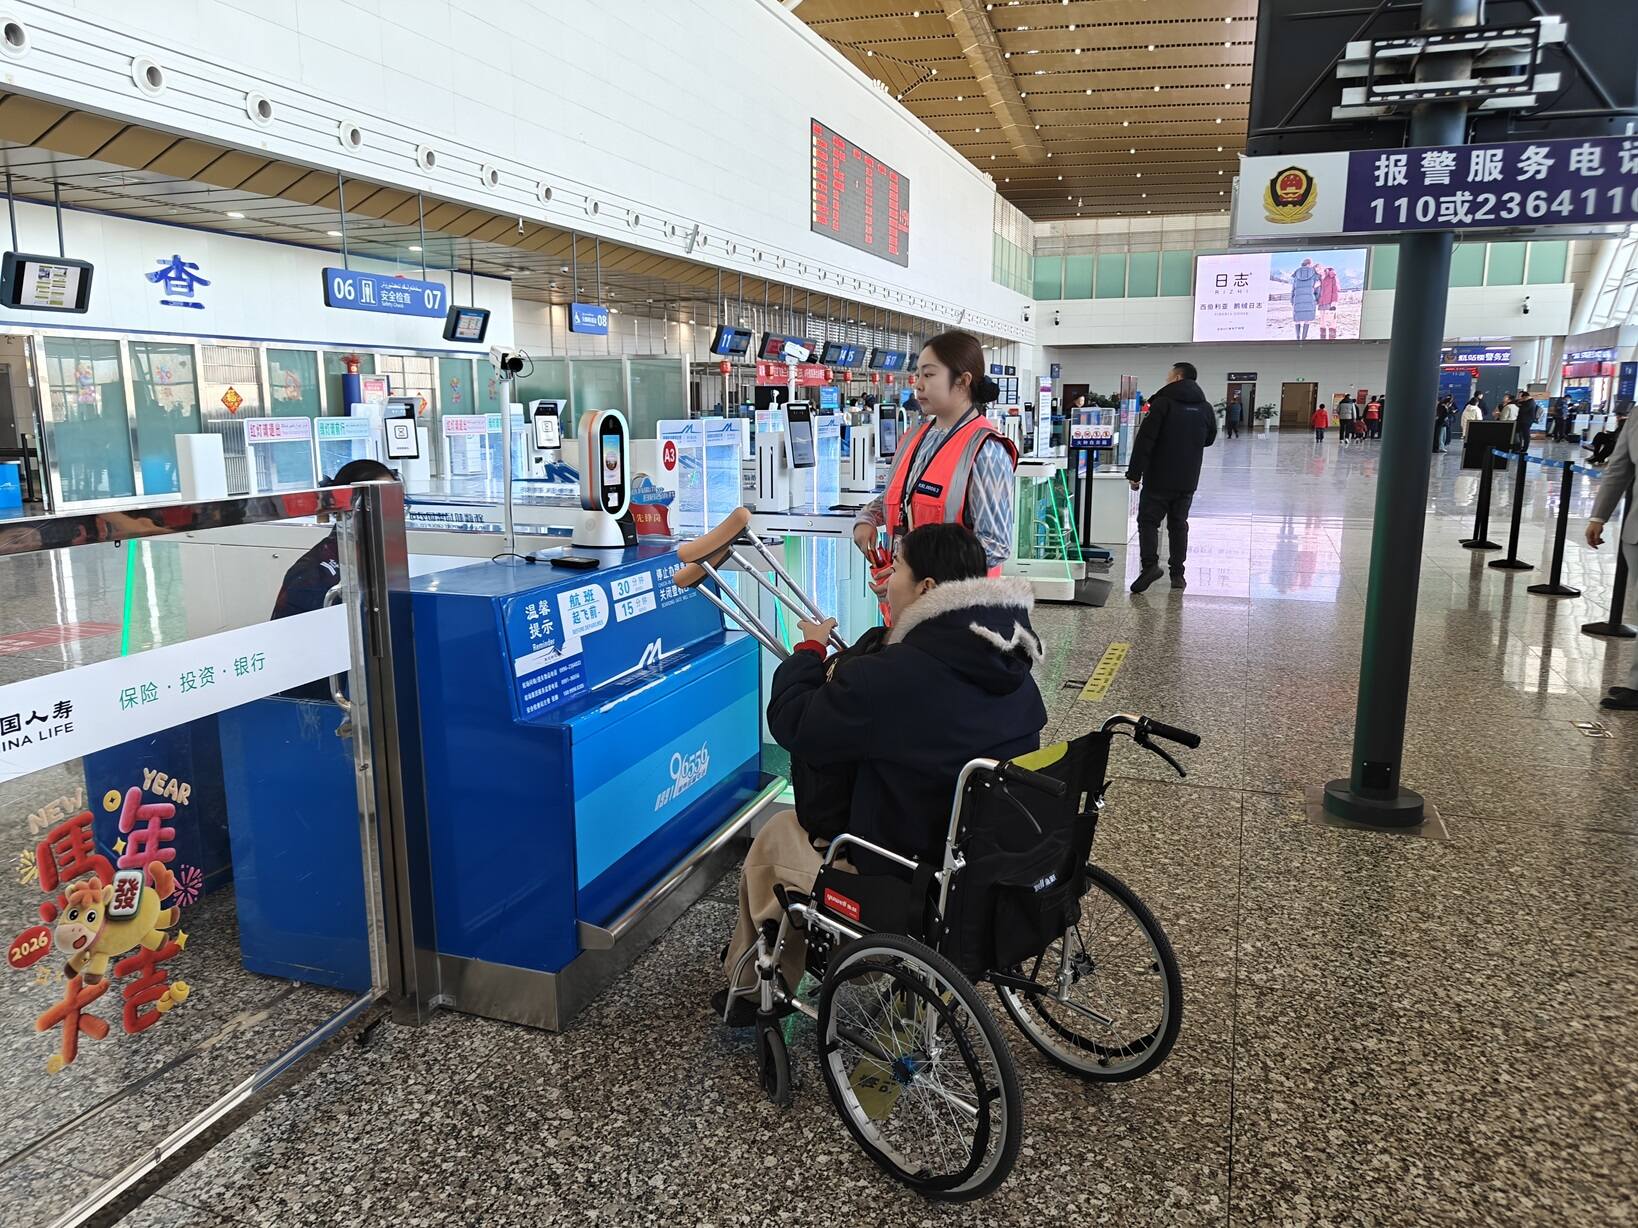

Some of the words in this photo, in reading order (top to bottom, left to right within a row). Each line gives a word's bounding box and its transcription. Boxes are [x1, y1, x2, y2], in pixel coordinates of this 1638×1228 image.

[145, 254, 211, 310] 查
[333, 277, 355, 300] 06
[1215, 272, 1249, 288] 日志
[380, 289, 411, 304] 安全检查
[424, 289, 442, 310] 07
[597, 314, 607, 327] 08
[723, 334, 732, 348] 11
[664, 450, 676, 464] A3
[569, 588, 595, 608] 航班
[617, 580, 630, 596] 30
[525, 599, 551, 620] 温馨
[572, 605, 598, 624] 起飞前
[622, 601, 634, 617] 15
[528, 619, 554, 640] 提示
[39, 721, 75, 741] LIFE
[669, 740, 710, 788] 96556
[143, 767, 192, 806] YEAR
[27, 787, 83, 835] NEW
[115, 877, 140, 911] 發
[11, 926, 49, 962] 2026
